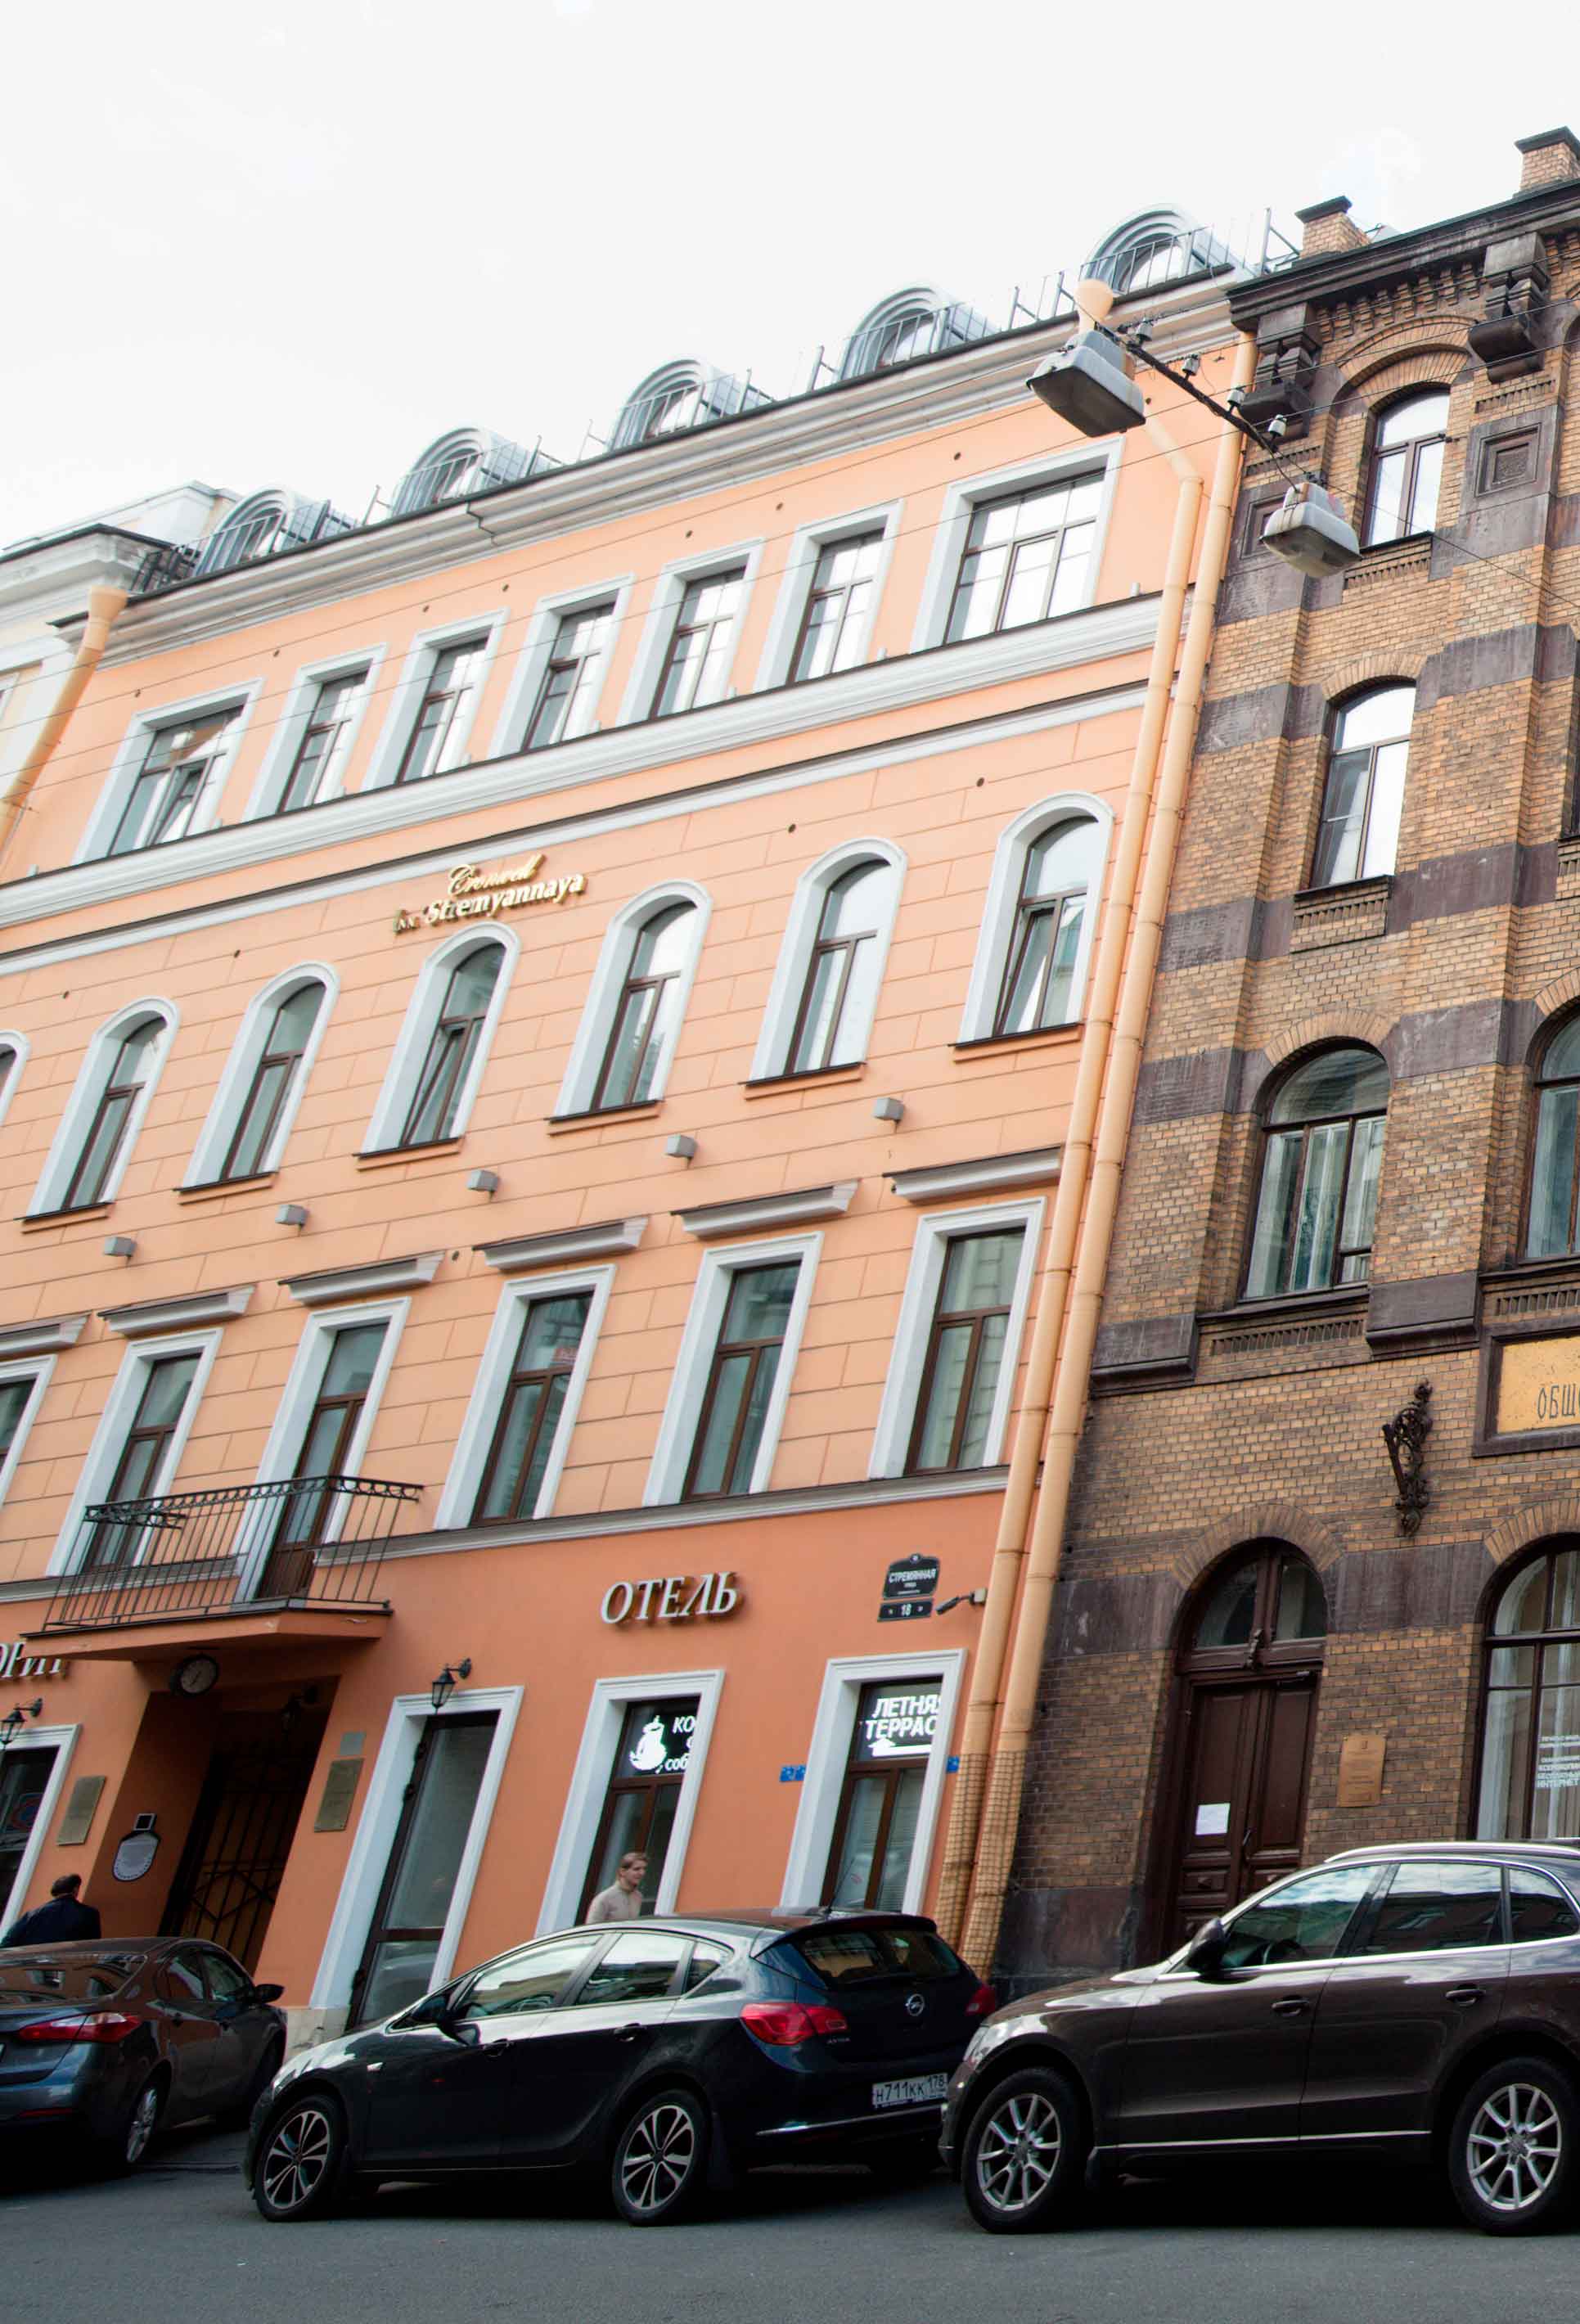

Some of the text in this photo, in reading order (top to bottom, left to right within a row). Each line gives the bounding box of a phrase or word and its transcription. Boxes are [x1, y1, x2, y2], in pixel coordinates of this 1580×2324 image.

[424, 874, 587, 925] Stremyannaya
[1537, 1384, 1580, 1420] ОБЩ
[601, 1571, 737, 1624] ОТЕЛЬ
[864, 1714, 937, 1741] ТЕРРАС
